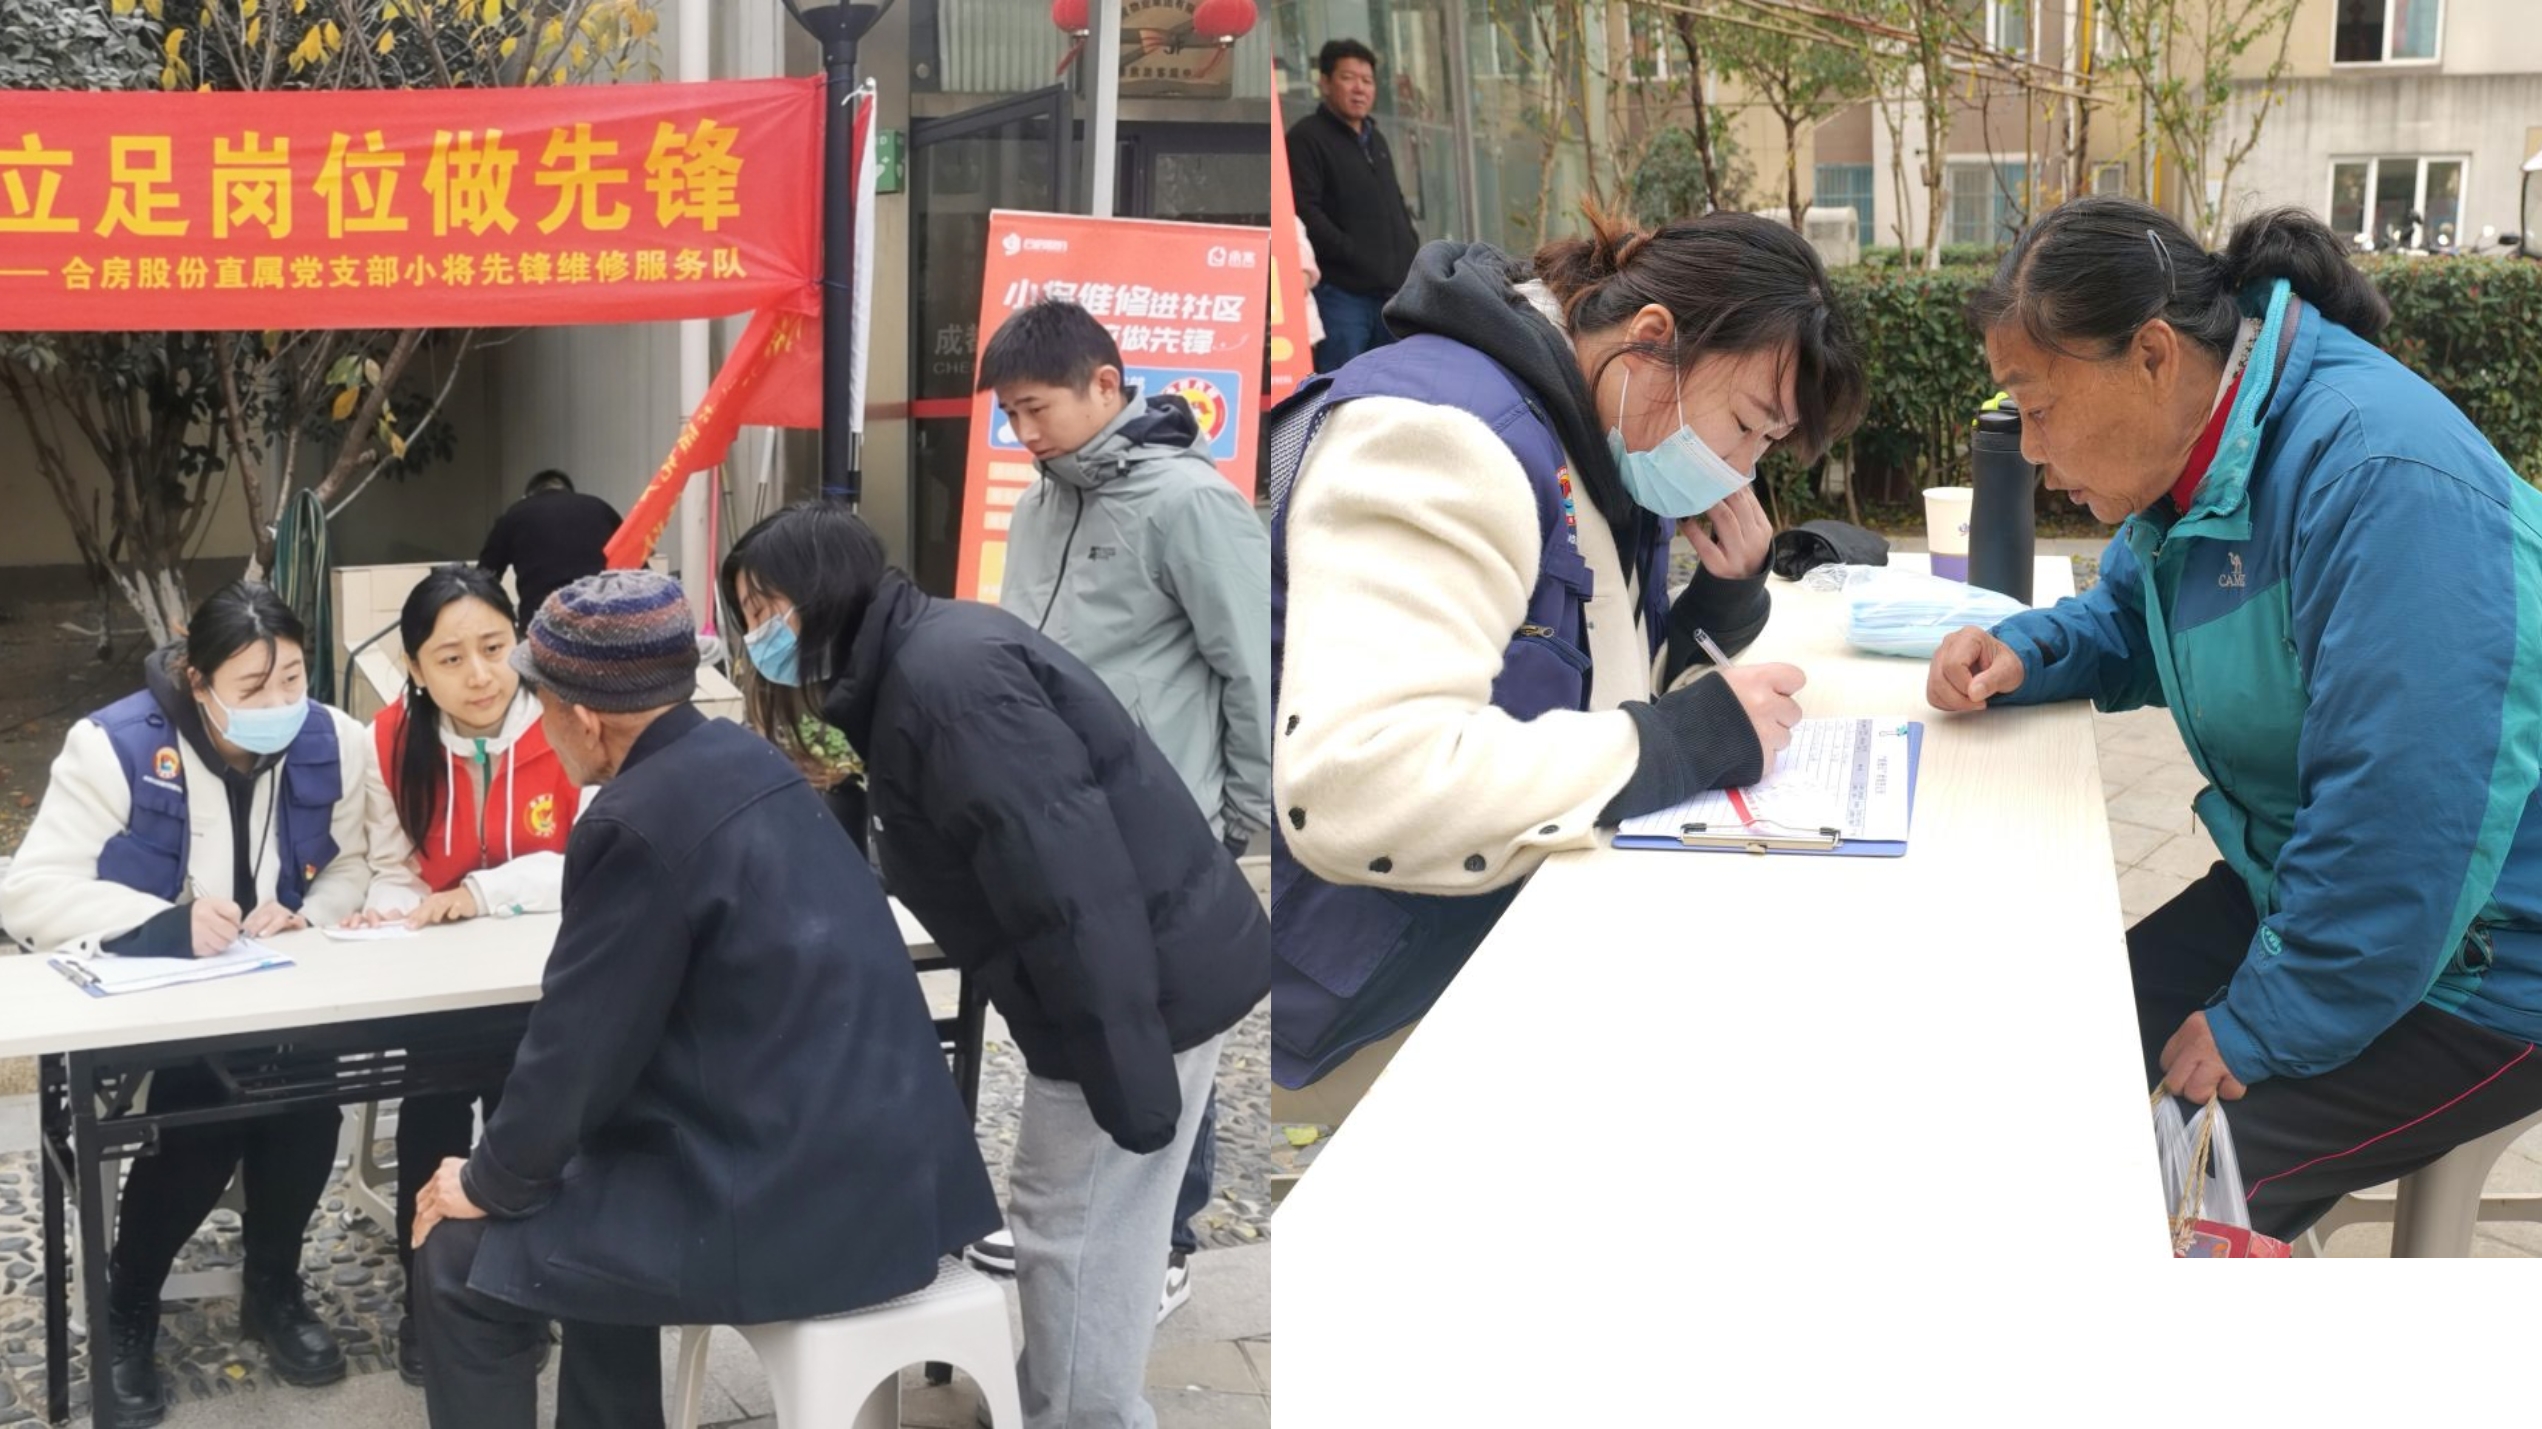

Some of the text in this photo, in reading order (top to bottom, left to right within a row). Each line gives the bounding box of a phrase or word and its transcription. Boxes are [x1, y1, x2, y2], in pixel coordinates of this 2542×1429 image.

[0, 118, 744, 239] 立足岗位做先锋
[61, 247, 748, 290] 合房股份直属党支部小将先锋维修服务队
[1103, 323, 1215, 355] 做先锋
[933, 361, 974, 375] CHE
